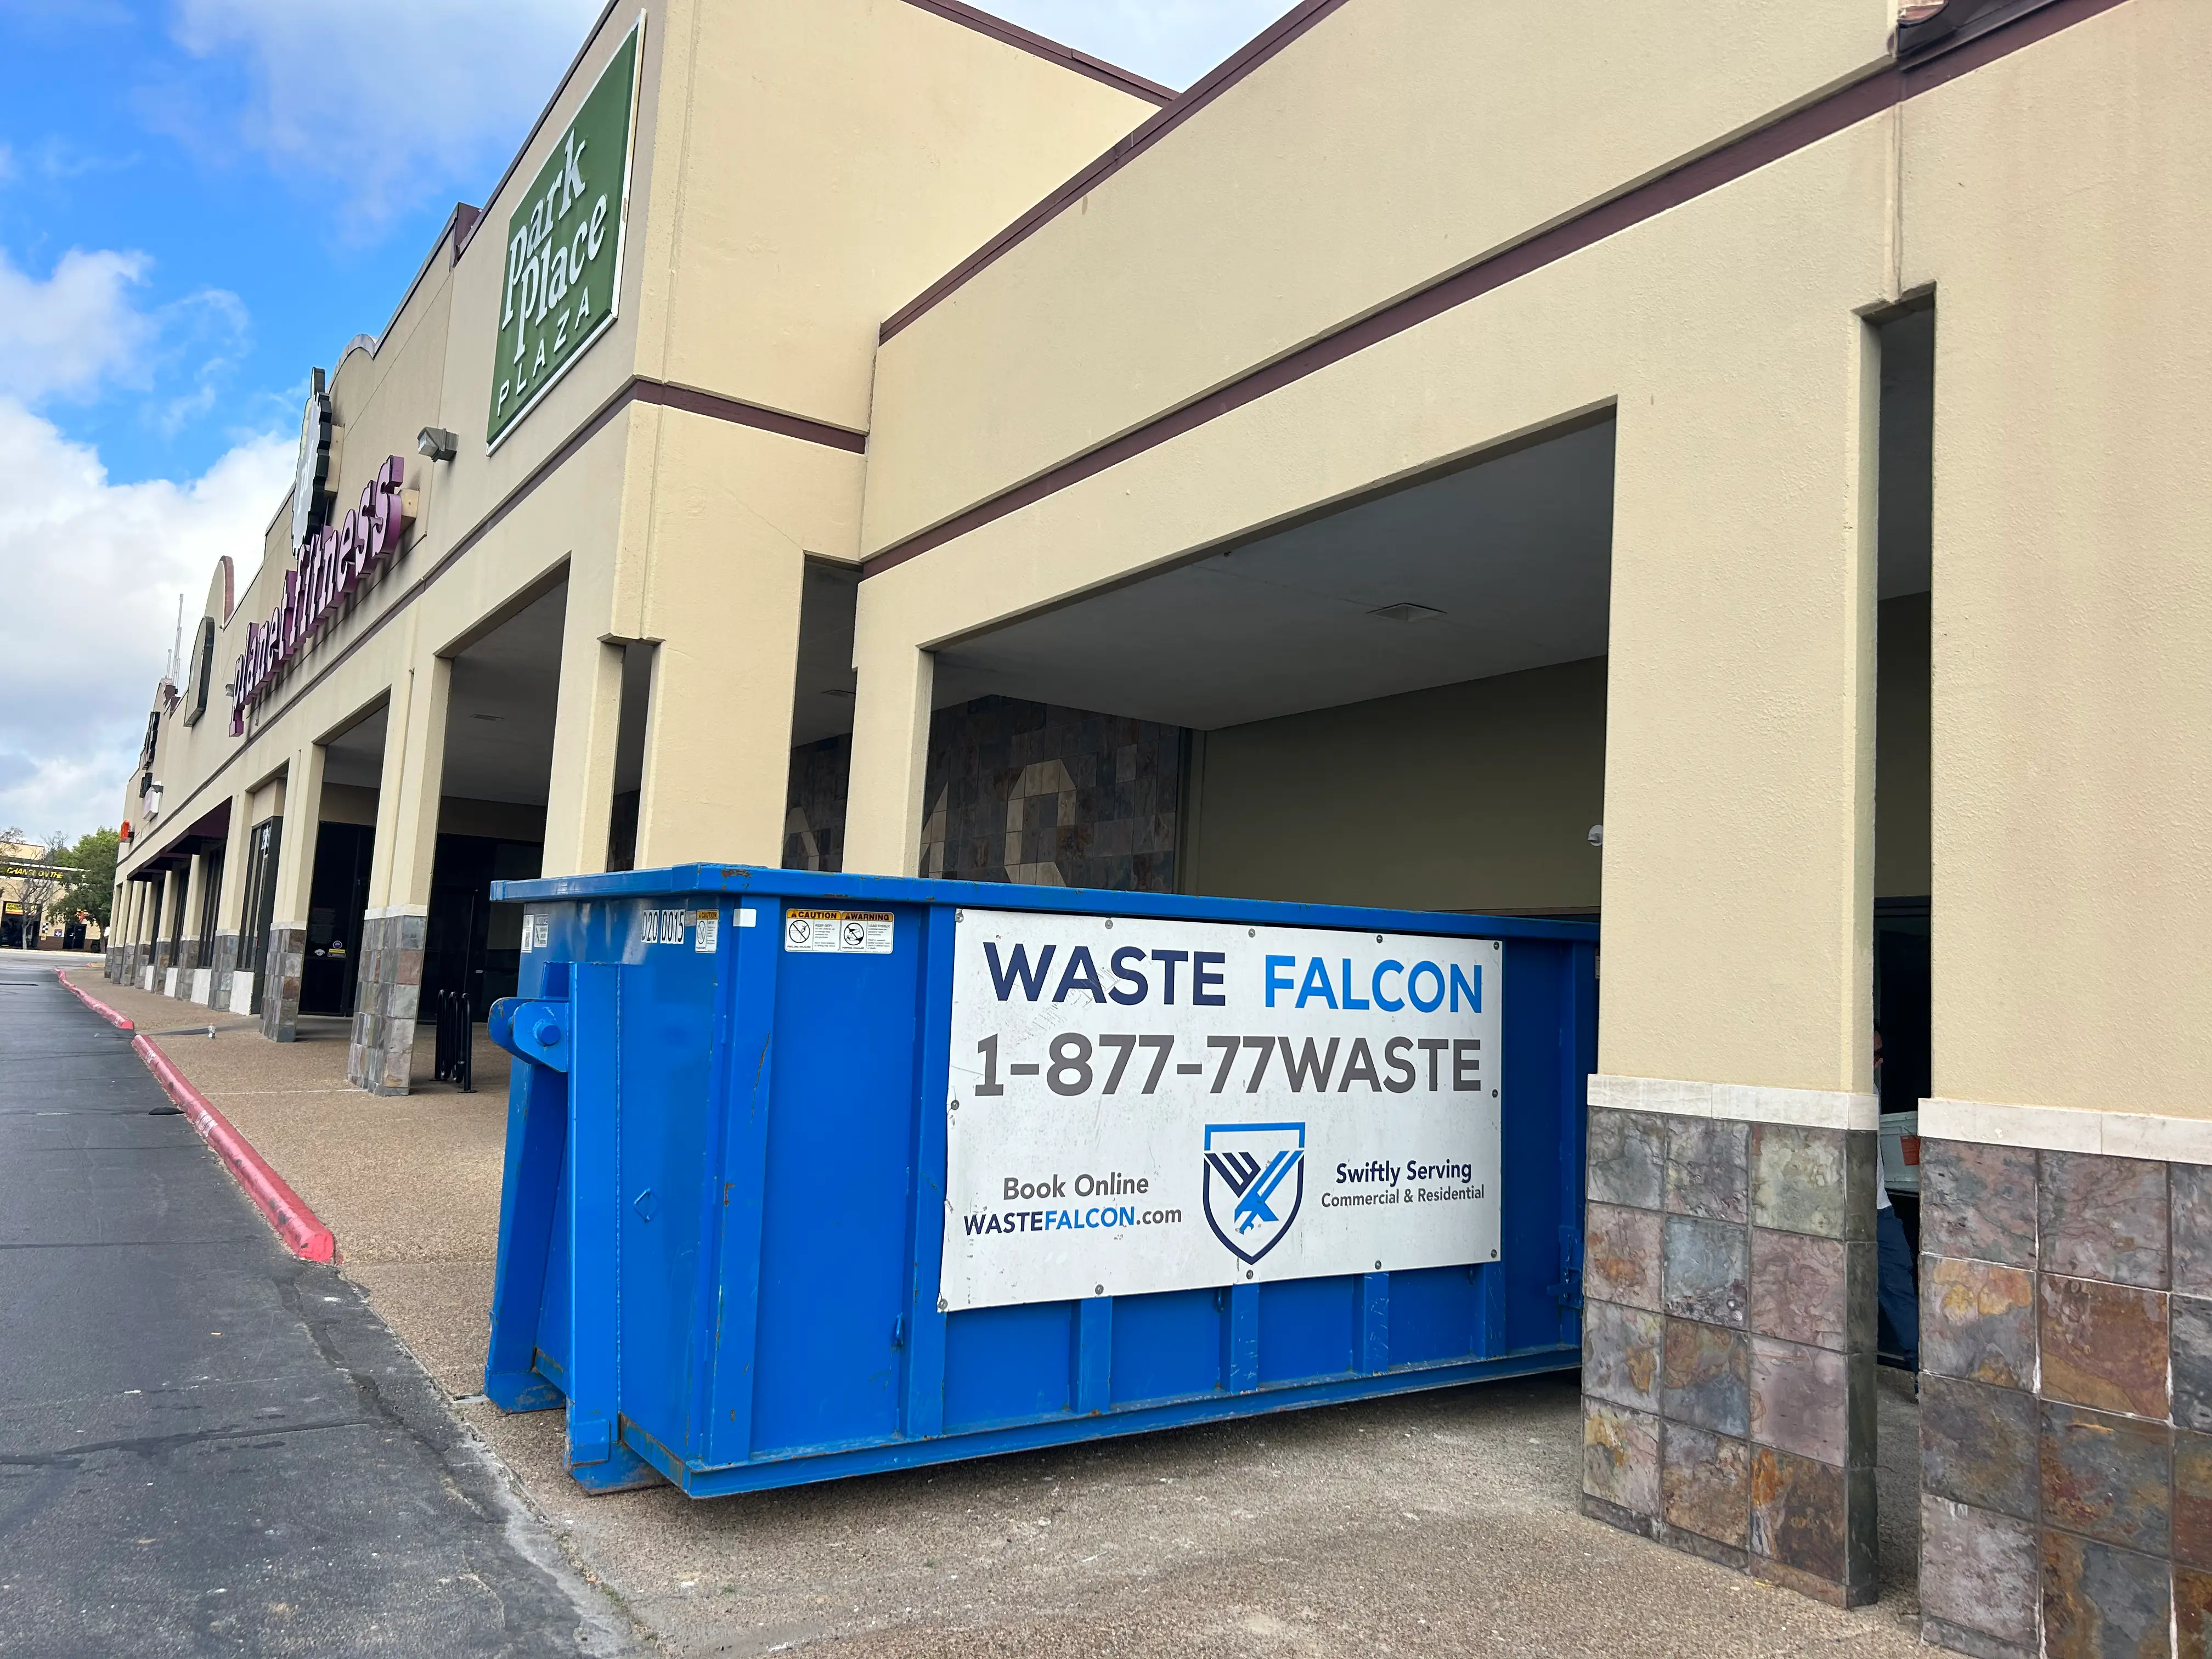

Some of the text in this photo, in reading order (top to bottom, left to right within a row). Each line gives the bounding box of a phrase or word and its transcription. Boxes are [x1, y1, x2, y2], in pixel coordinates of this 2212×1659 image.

[502, 127, 585, 330] park
[514, 195, 607, 365] place
[497, 286, 590, 418] PLAZA
[229, 455, 404, 737] planet fitness
[662, 911, 684, 943] 0015
[983, 942, 1482, 1014] WASTE FALCON
[975, 1032, 1481, 1097] 1-877-77WASTE
[1003, 1172, 1149, 1200] Book Online
[1321, 1183, 1485, 1208] Commercial & Residential
[1336, 1160, 1472, 1188] Swiftly Serving
[963, 1206, 1182, 1236] WASTEFALCON.com
